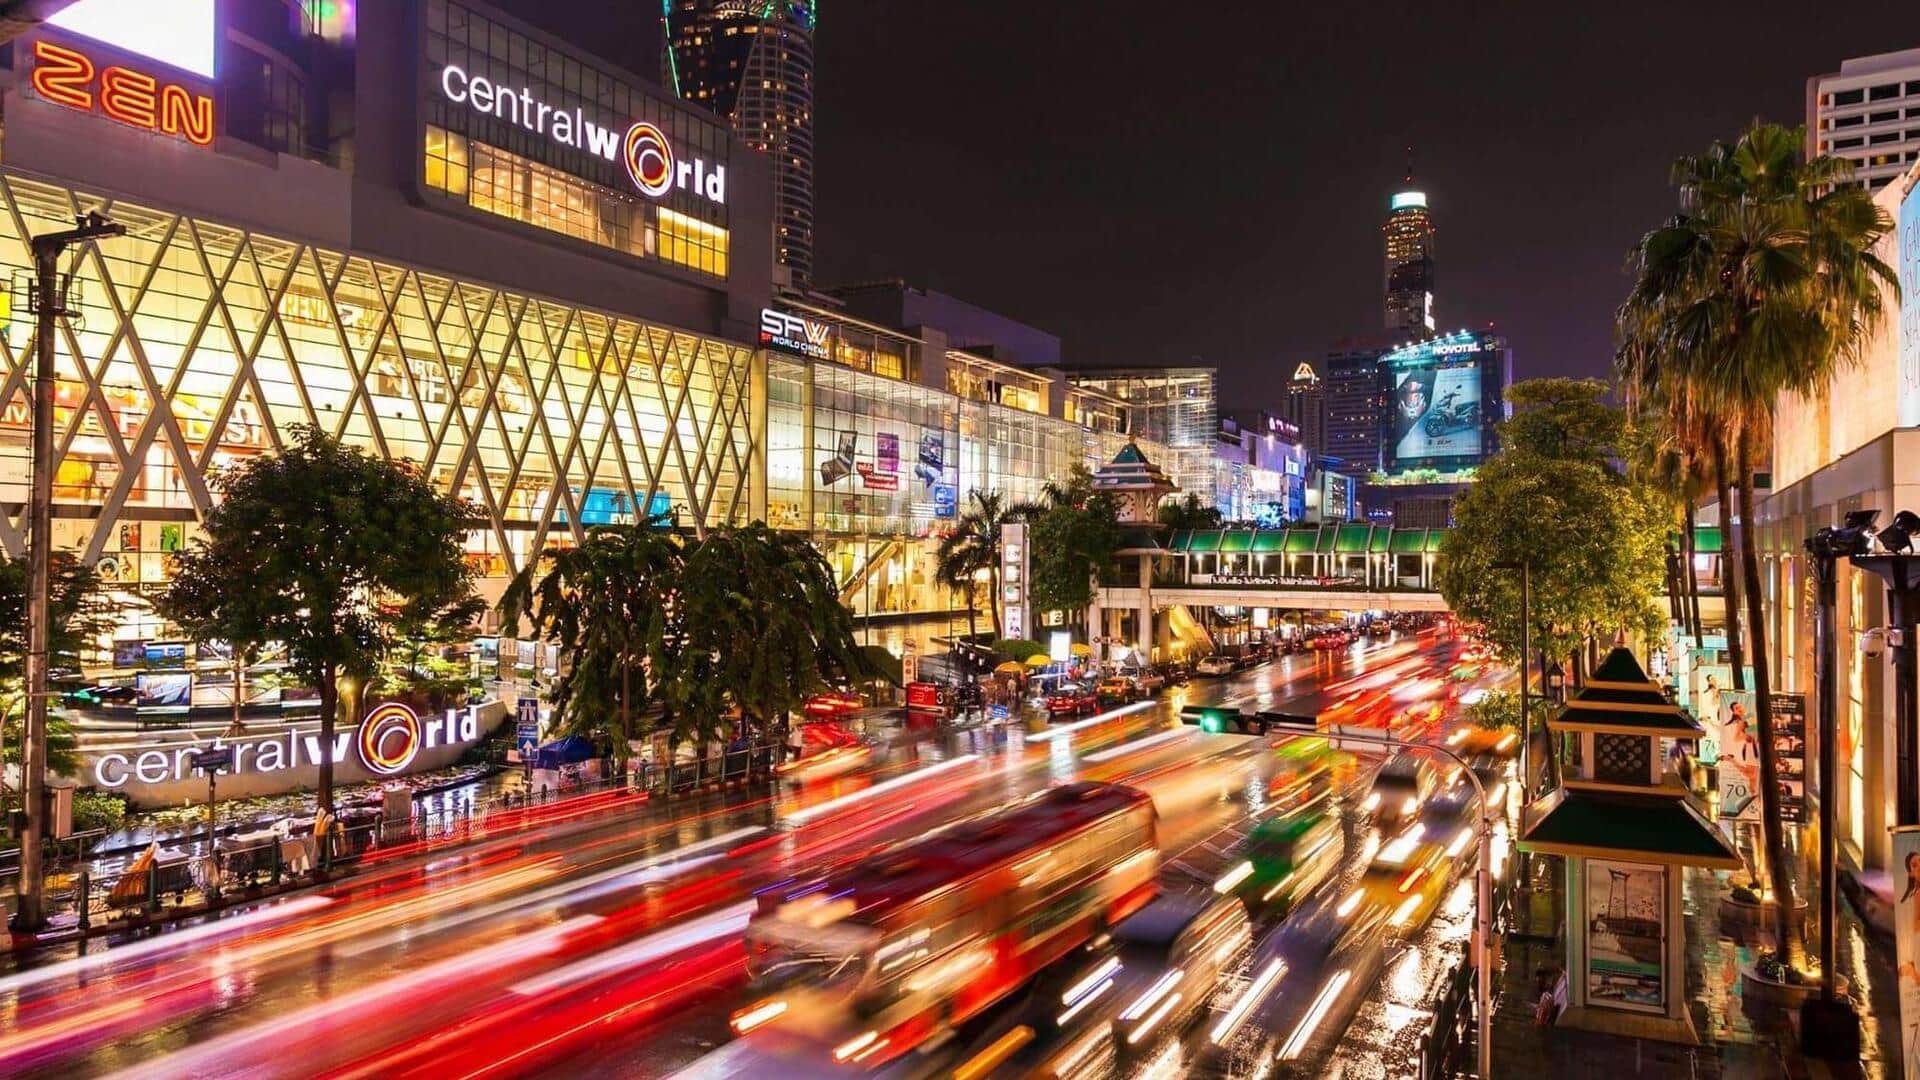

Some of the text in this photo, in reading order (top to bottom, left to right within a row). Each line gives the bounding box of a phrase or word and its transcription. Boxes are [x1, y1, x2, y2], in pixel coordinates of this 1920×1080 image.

[33, 40, 213, 144] ZEN
[772, 336, 800, 348] WORLD
[1432, 341, 1481, 355] NOVOTEL
[1726, 784, 1747, 799] 70
